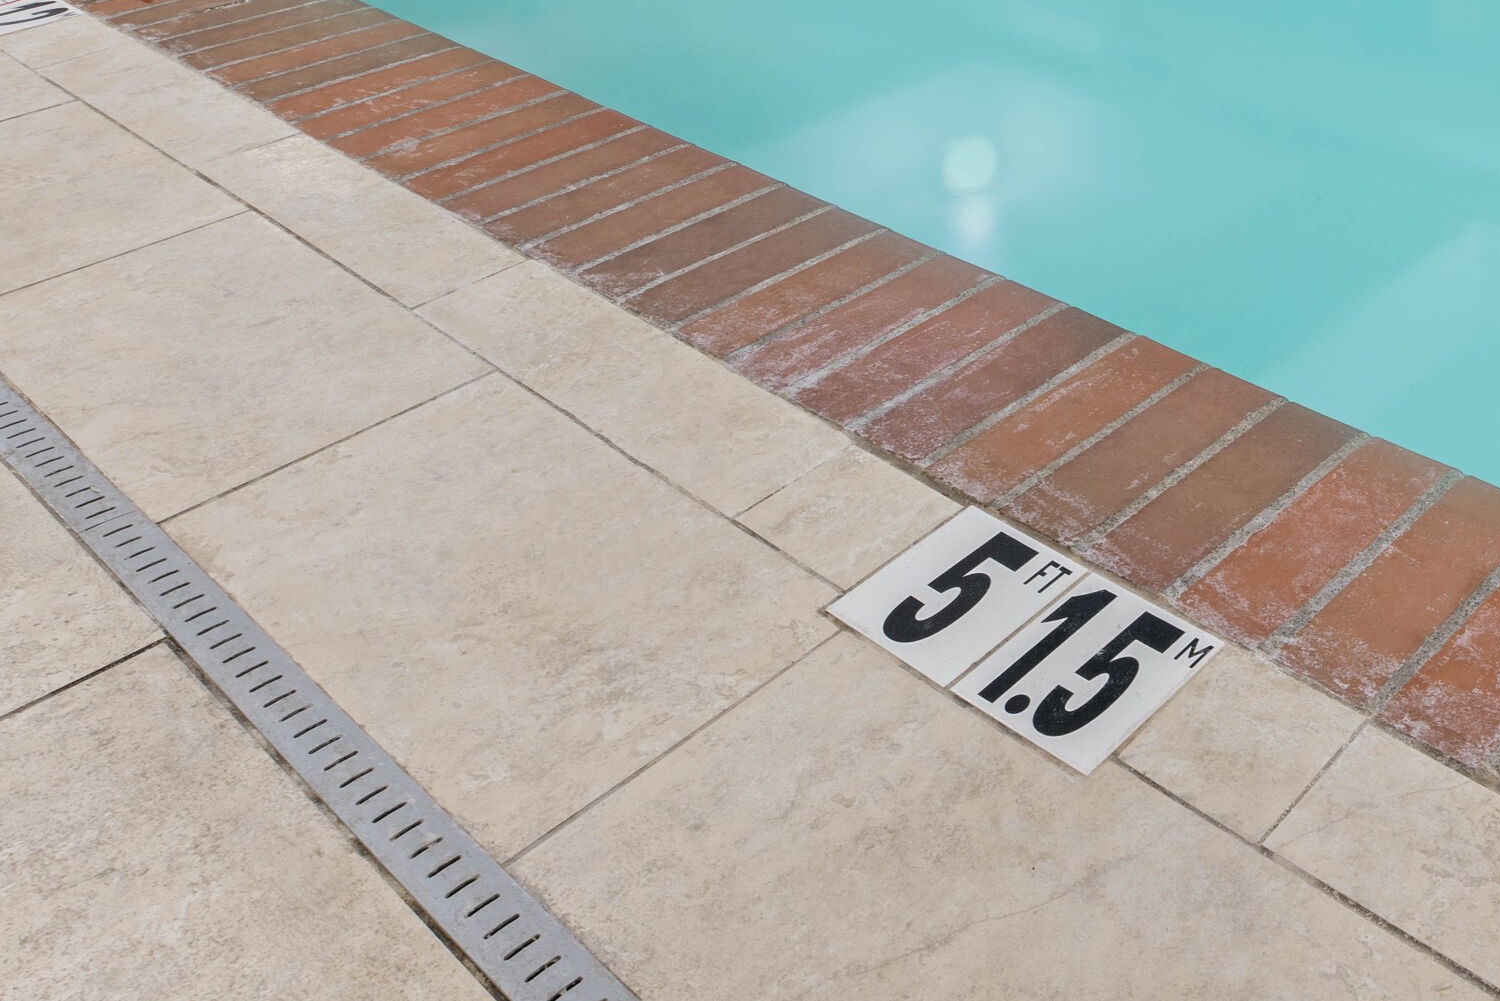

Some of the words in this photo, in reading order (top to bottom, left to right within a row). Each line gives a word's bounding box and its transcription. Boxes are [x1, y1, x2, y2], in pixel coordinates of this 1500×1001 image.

[882, 531, 1039, 643] 5
[1023, 560, 1073, 593] FT
[978, 589, 1186, 737] 1.5
[1175, 637, 1213, 669] M
